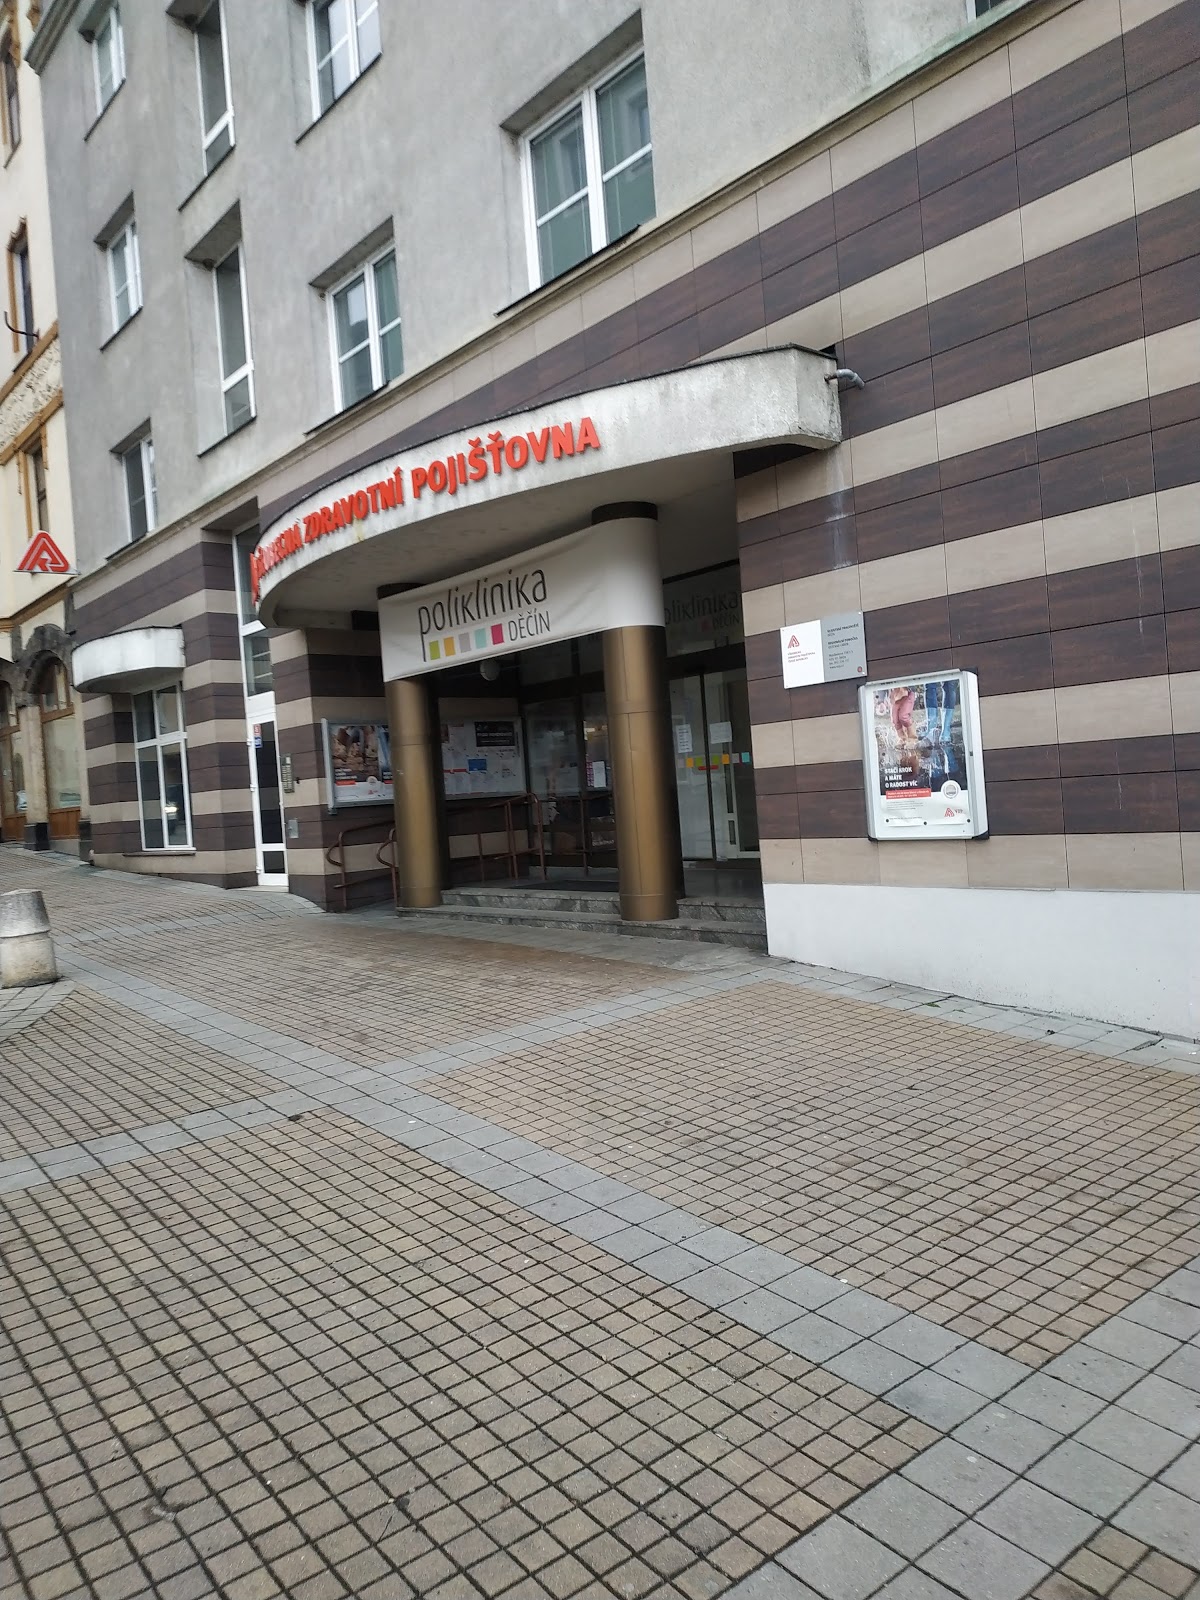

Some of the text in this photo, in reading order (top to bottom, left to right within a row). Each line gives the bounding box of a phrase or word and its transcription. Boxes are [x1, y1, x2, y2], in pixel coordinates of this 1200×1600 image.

[303, 466, 404, 541] ZDRAVOTNÍ
[411, 417, 600, 496] POJIŠŤOVNA
[418, 568, 547, 662] poliklinika
[508, 607, 551, 642] DĚČÍN
[664, 590, 738, 625] oliklinika
